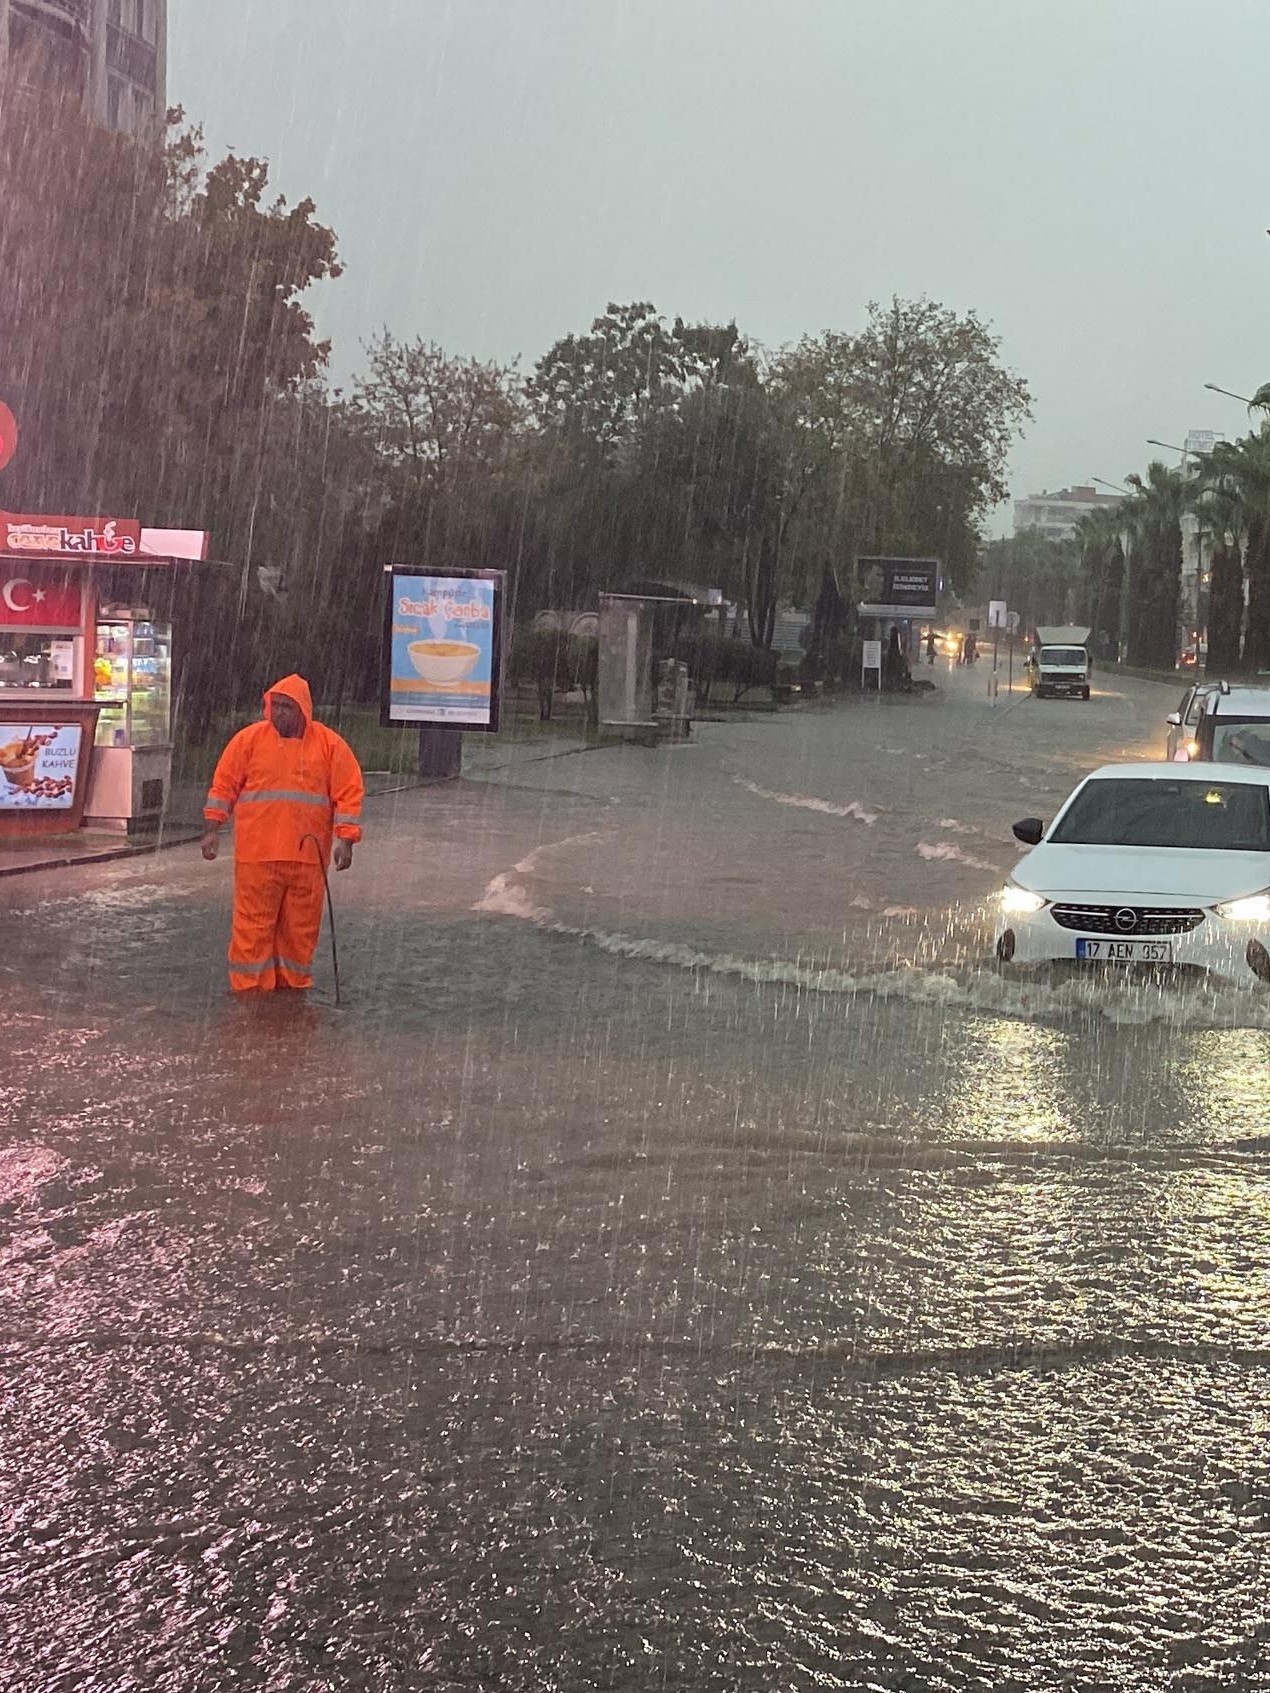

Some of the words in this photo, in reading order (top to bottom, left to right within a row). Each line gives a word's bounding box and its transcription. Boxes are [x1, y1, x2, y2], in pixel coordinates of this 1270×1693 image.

[44, 747, 77, 757] BUZLU
[41, 759, 76, 769] KAHVE
[1087, 942, 1100, 958] 17
[1107, 943, 1134, 959] AEN
